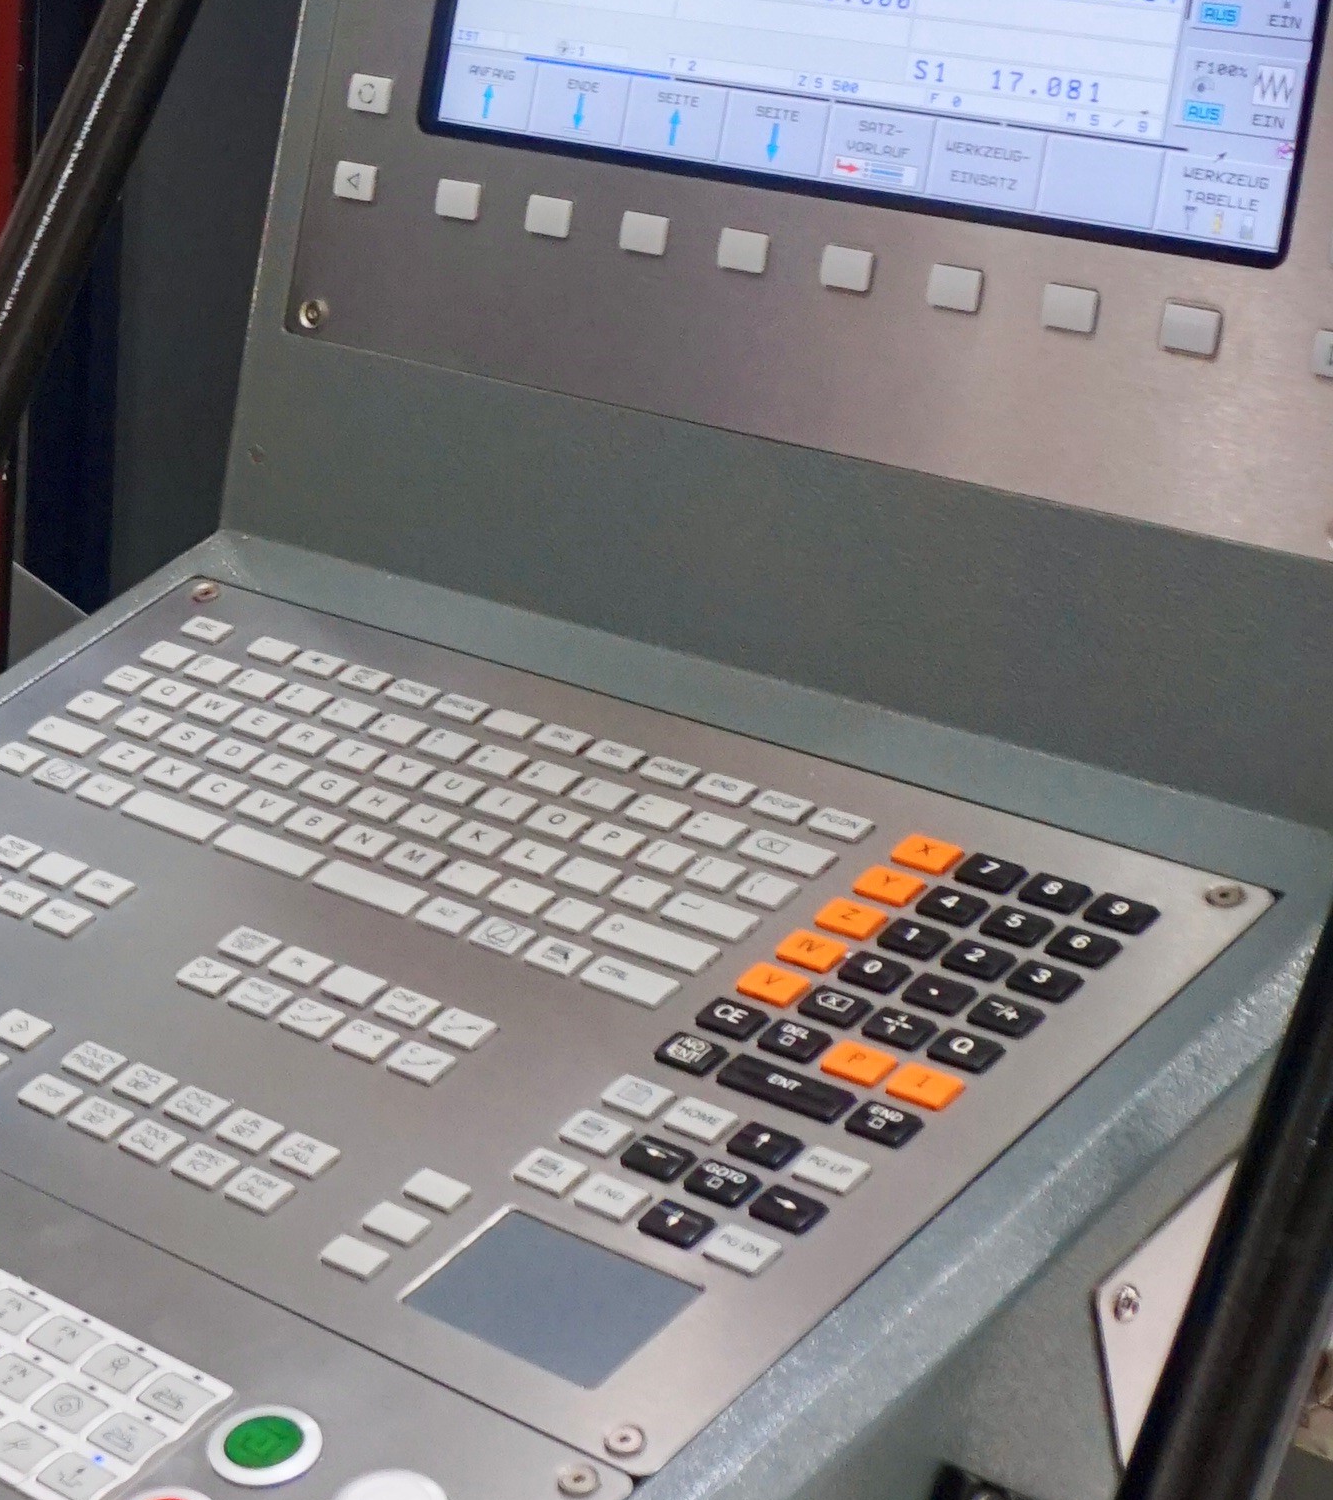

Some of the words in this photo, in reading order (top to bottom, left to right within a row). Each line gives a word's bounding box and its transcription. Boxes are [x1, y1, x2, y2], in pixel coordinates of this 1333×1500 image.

[1204, 8, 1237, 23] AUS
[1268, 15, 1302, 29] EIN
[470, 65, 515, 81] ANFANG
[567, 80, 599, 93] ENDE
[913, 60, 946, 83] S1
[991, 70, 1101, 103] 17.081
[657, 92, 699, 108] SEITE
[756, 104, 800, 122] SEITE
[1187, 106, 1220, 122] AUS
[1252, 114, 1285, 129] EIN
[950, 169, 1019, 191] EINSATZ
[1184, 190, 1259, 212] TABELLE
[980, 861, 1000, 874] 7
[1043, 880, 1063, 895] 8
[940, 895, 961, 911] 4
[1109, 901, 1130, 916] 9
[1005, 913, 1024, 929] 5
[905, 927, 921, 941] 1
[1070, 934, 1091, 950] 6
[966, 948, 987, 962] 2
[863, 960, 883, 976] 0
[1032, 968, 1053, 984] 3
[713, 1004, 748, 1023] CE
[952, 1037, 975, 1055] Q
[766, 1074, 801, 1090] ENT
[679, 1106, 721, 1127] HOME
[867, 1102, 904, 1122] END
[704, 1161, 748, 1182] GOTO
